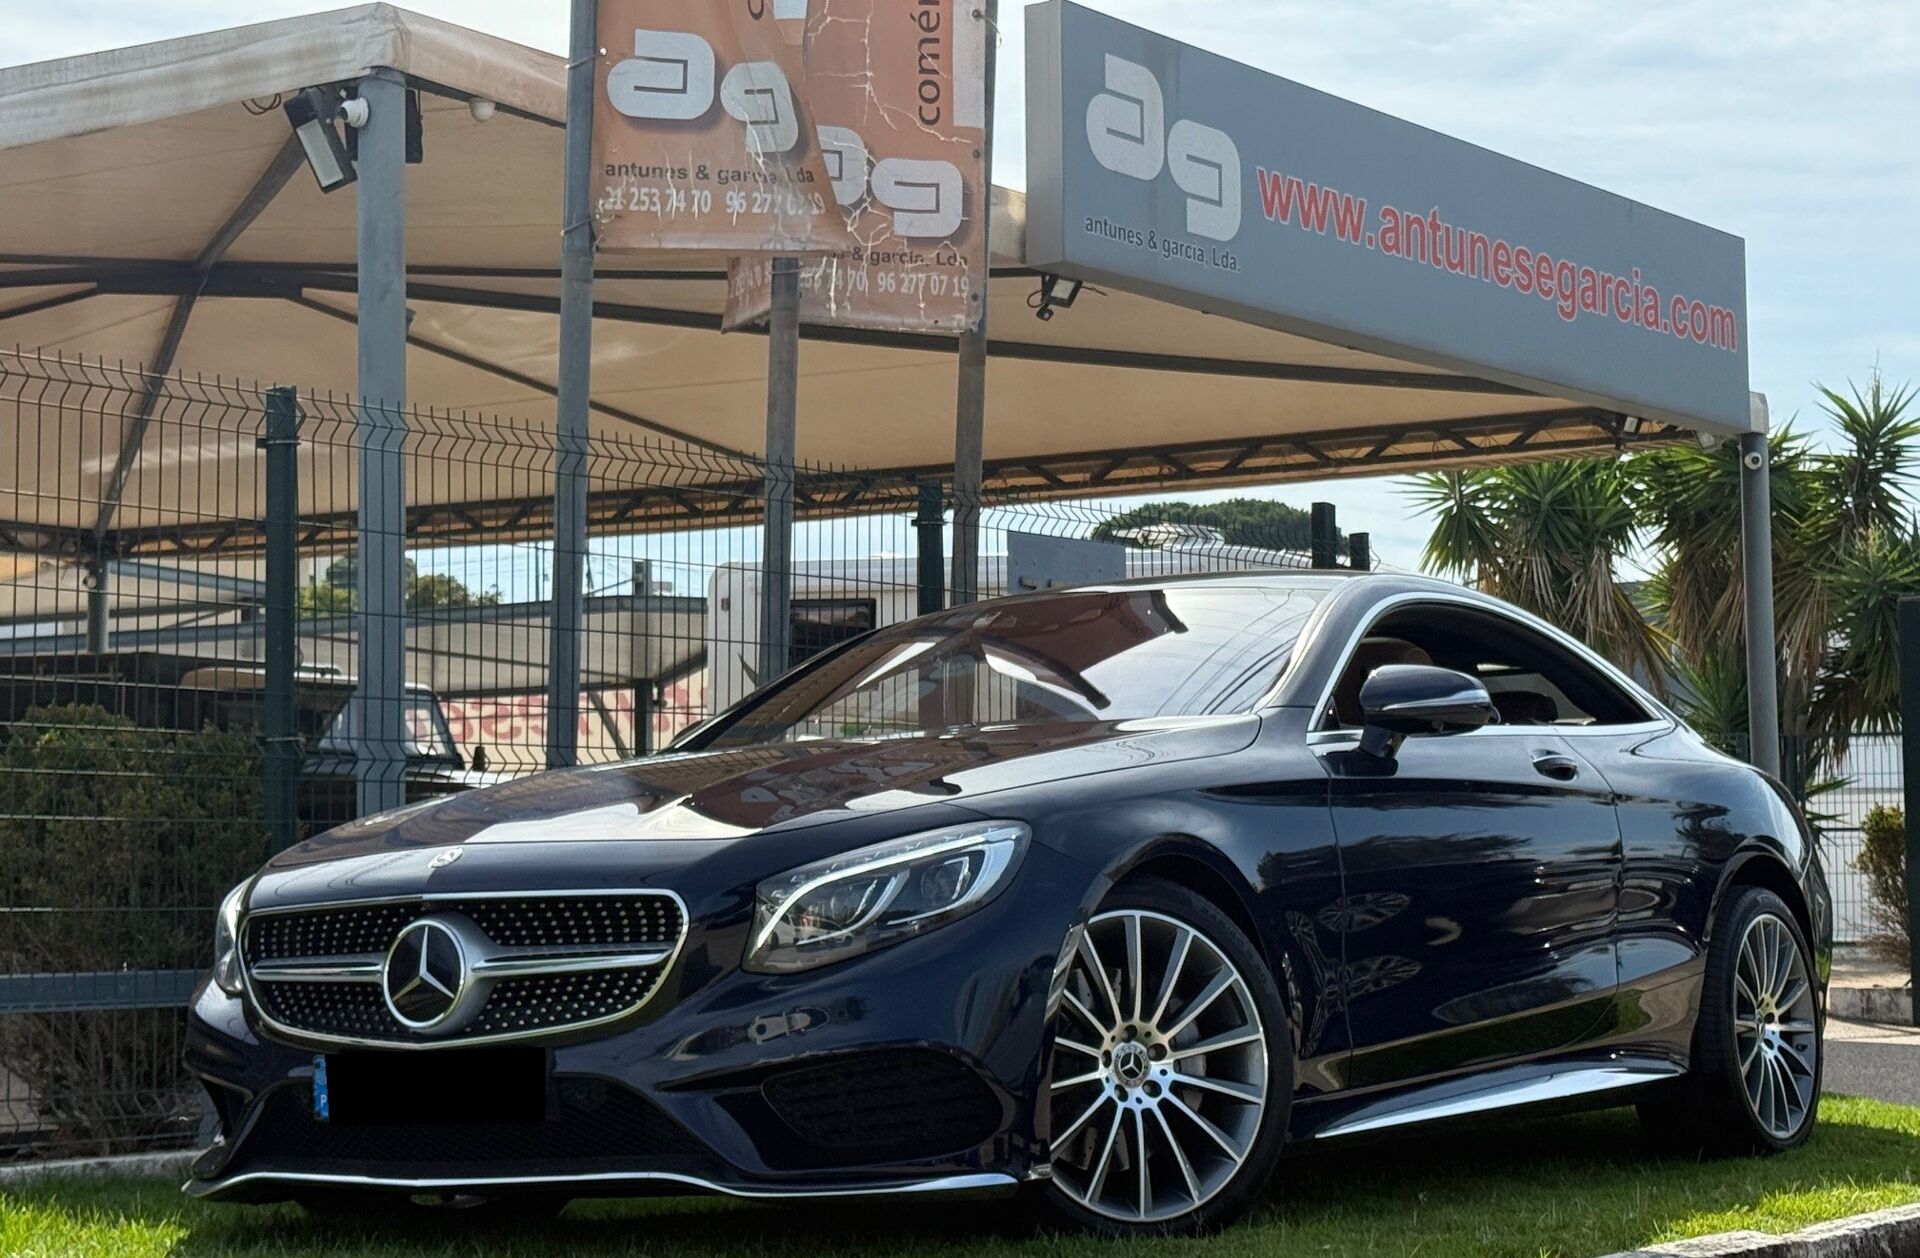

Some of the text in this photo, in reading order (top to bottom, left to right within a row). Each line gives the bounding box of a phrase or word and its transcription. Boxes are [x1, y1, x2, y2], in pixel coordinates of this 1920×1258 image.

[605, 162, 689, 180] antunes
[695, 164, 710, 180] &
[629, 187, 661, 212] 253
[665, 190, 686, 212] 74
[691, 190, 712, 214] 70
[725, 190, 747, 215] 96
[852, 246, 864, 261] &
[1085, 216, 1144, 248] antunes
[1148, 229, 1158, 251] &
[1212, 247, 1241, 272] Lda.
[1256, 166, 1739, 353] www.antunesegarcia.com
[877, 271, 896, 294] 96
[900, 272, 927, 295] 277
[930, 274, 950, 296] 07
[952, 275, 970, 297] 19
